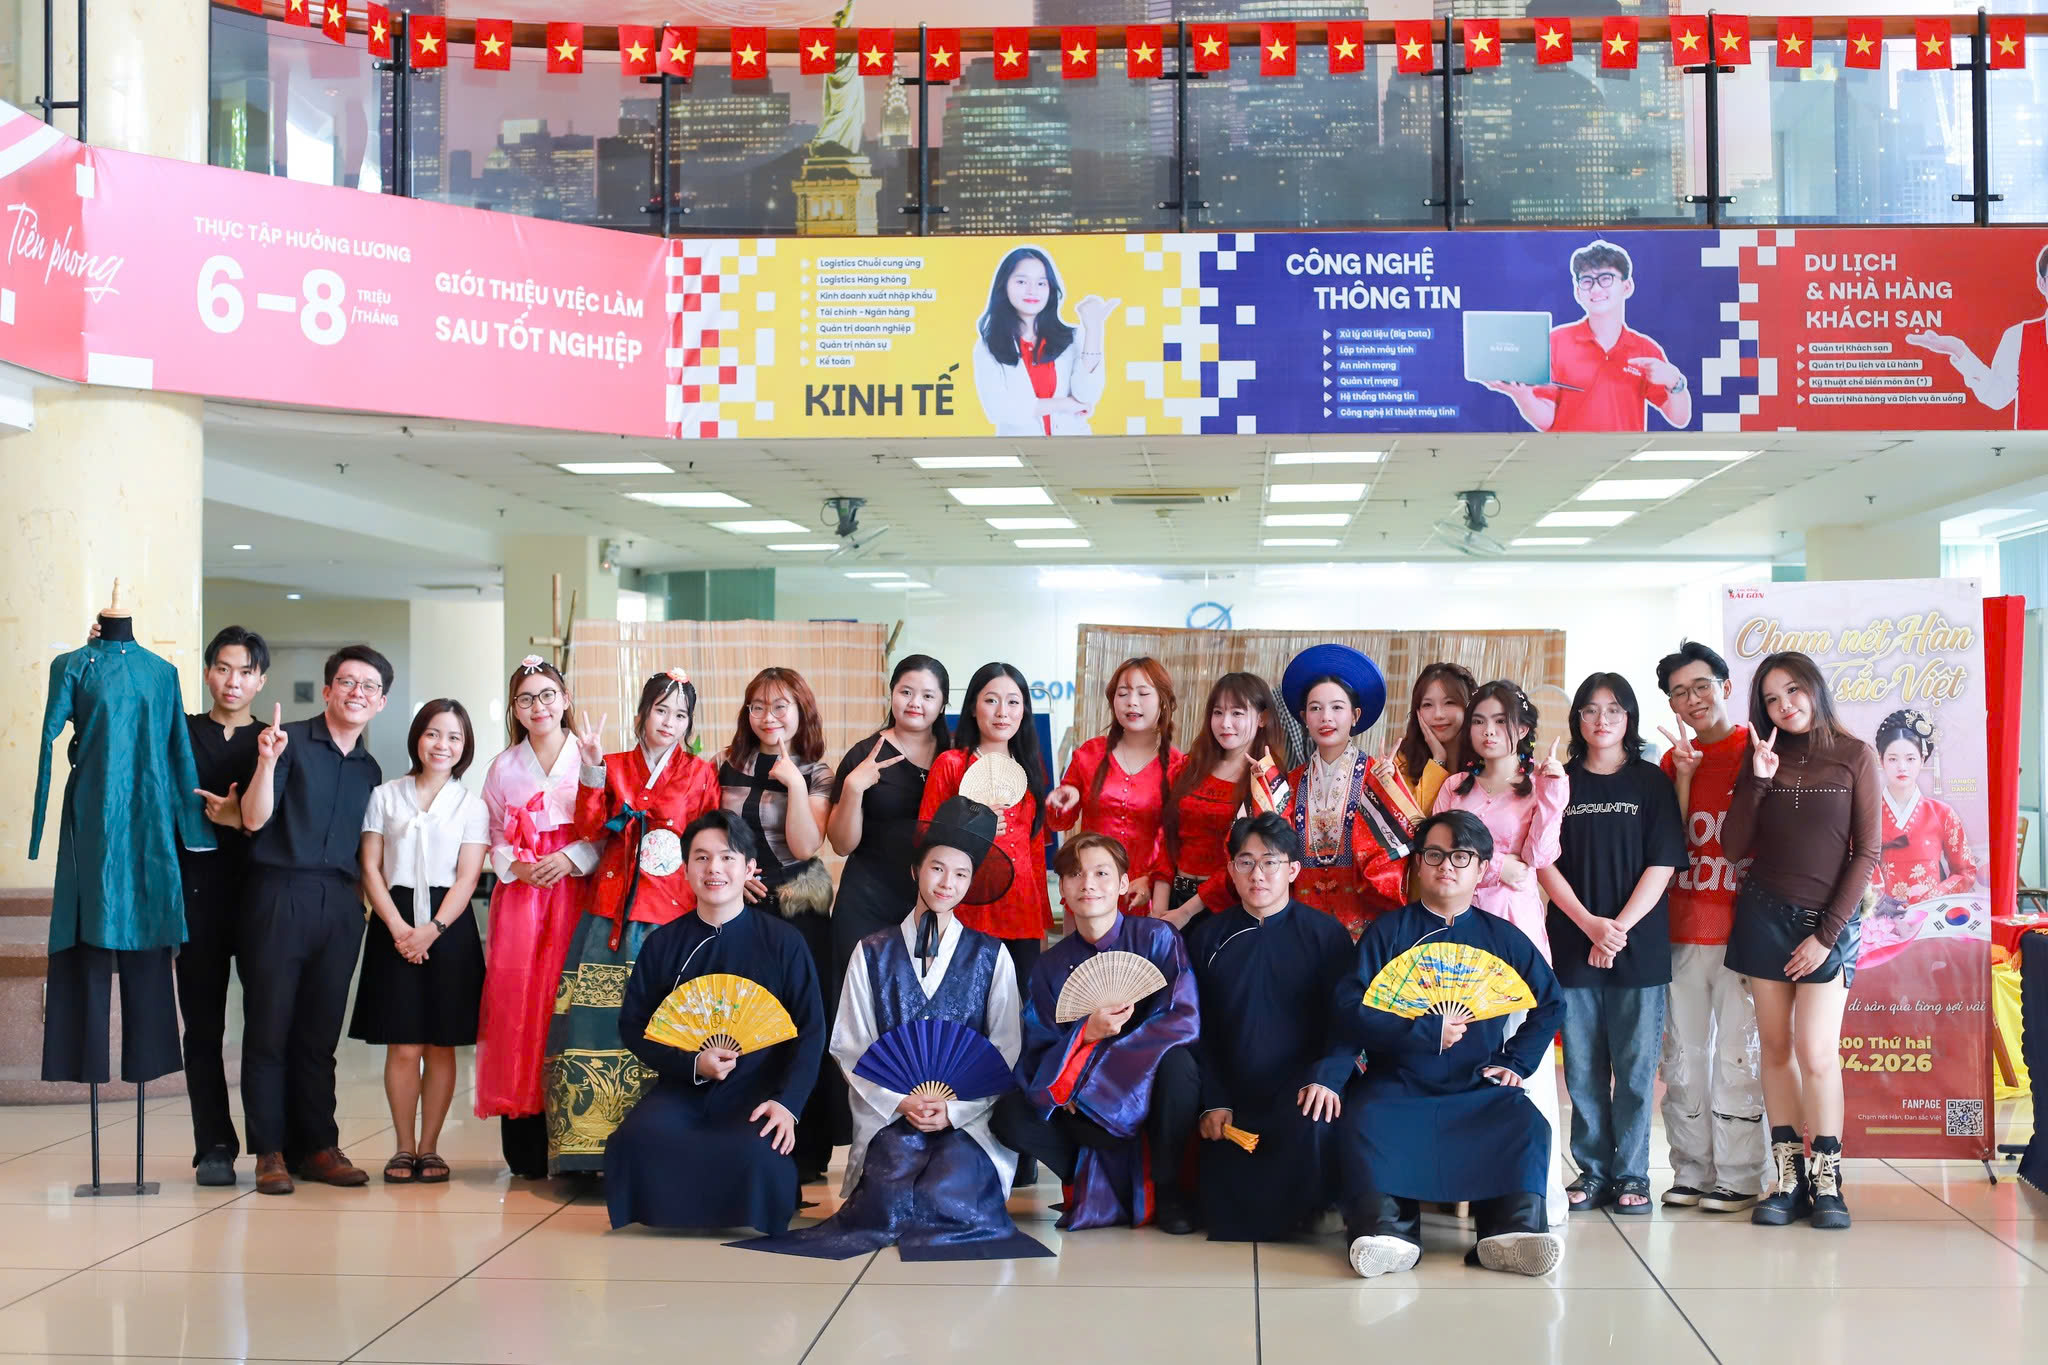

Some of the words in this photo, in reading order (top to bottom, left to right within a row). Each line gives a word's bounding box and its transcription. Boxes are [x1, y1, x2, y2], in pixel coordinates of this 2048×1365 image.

[194, 216, 244, 241] THỰC
[248, 222, 282, 248] TẬP
[286, 228, 350, 254] HƯỞNG
[353, 239, 411, 263] LƯƠNG
[7, 202, 47, 265] Tiên
[45, 225, 124, 303] phong
[820, 259, 856, 269] Logistics
[882, 260, 903, 269] cung
[1286, 247, 1362, 276] CÔNG
[1365, 246, 1434, 282] NGHỆ
[1804, 254, 1836, 271] DU
[1842, 254, 1896, 277] LỊCH
[820, 275, 855, 285] Logistics
[857, 276, 879, 285] Hàng
[880, 276, 906, 285] không
[435, 269, 484, 297] GIỚI
[489, 278, 549, 310] THIỆU
[552, 286, 600, 317] VIỆC
[603, 290, 644, 318] LÀM
[1806, 282, 1824, 299] &
[1829, 277, 1879, 299] NHÀ
[1885, 276, 1953, 299] HÀNG
[357, 289, 391, 307] TRIỆU
[868, 290, 887, 299] xuất
[888, 292, 910, 301] nhập
[1313, 279, 1410, 310] THÔNG
[1414, 286, 1461, 309] TIN
[351, 306, 399, 326] /THÁNG
[834, 308, 857, 316] chính
[864, 308, 887, 317] Ngân
[889, 308, 910, 317] hàng
[1806, 305, 1889, 328] KHÁCH
[1895, 310, 1942, 333] SẠN
[843, 325, 853, 334] trị
[882, 325, 911, 334] nghiệp
[1351, 330, 1360, 340] lý
[1373, 330, 1389, 340] liệu
[1390, 328, 1406, 340] (Big
[1407, 329, 1431, 340] Data)
[435, 315, 488, 345] SAU
[494, 312, 544, 352] TỐT
[549, 331, 642, 369] NGHIỆP
[843, 341, 853, 350] trị
[1340, 345, 1354, 356] Lập
[1355, 345, 1376, 353] trình
[1377, 345, 1396, 356] máy
[1397, 345, 1414, 353] tính
[1835, 345, 1845, 354] trị
[1846, 344, 1872, 352] Khách
[1873, 346, 1889, 354] sạn
[1340, 361, 1351, 369] An
[1352, 361, 1370, 369] ninh
[1371, 362, 1396, 371] mạng
[1835, 361, 1845, 370] trị
[1859, 361, 1874, 370] lịch
[1875, 361, 1886, 369] và
[1363, 377, 1373, 387] trị
[1374, 378, 1398, 387] mạng
[1824, 378, 1847, 387] thuật
[1848, 376, 1864, 385] chế
[1865, 376, 1883, 385] biến
[1884, 377, 1902, 385] món
[805, 384, 903, 416] KINH
[911, 363, 959, 416] TẾ
[1340, 392, 1351, 402] Hệ
[1352, 390, 1377, 402] thống
[1378, 392, 1402, 402] thông
[1403, 392, 1415, 400] tin
[1836, 396, 1845, 405] trị
[1864, 395, 1886, 404] hàng
[1898, 395, 1917, 404] Dịch
[1918, 396, 1929, 404] vụ
[1942, 393, 1964, 404] uống
[1340, 408, 1362, 418] Công
[1363, 408, 1384, 418] nghệ
[1394, 408, 1417, 418] thuật
[1418, 408, 1438, 418] máy
[1438, 407, 1455, 416] tính
[1838, 619, 1895, 655] nét
[1895, 611, 1977, 655] Hàn
[1834, 662, 1895, 702] sắc
[1892, 658, 1968, 707] Việt
[1848, 998, 1861, 1012] di
[1867, 1034, 1902, 1049] Thứ
[1905, 1035, 1932, 1049] hai
[1902, 1099, 1942, 1109] FANPAGE
